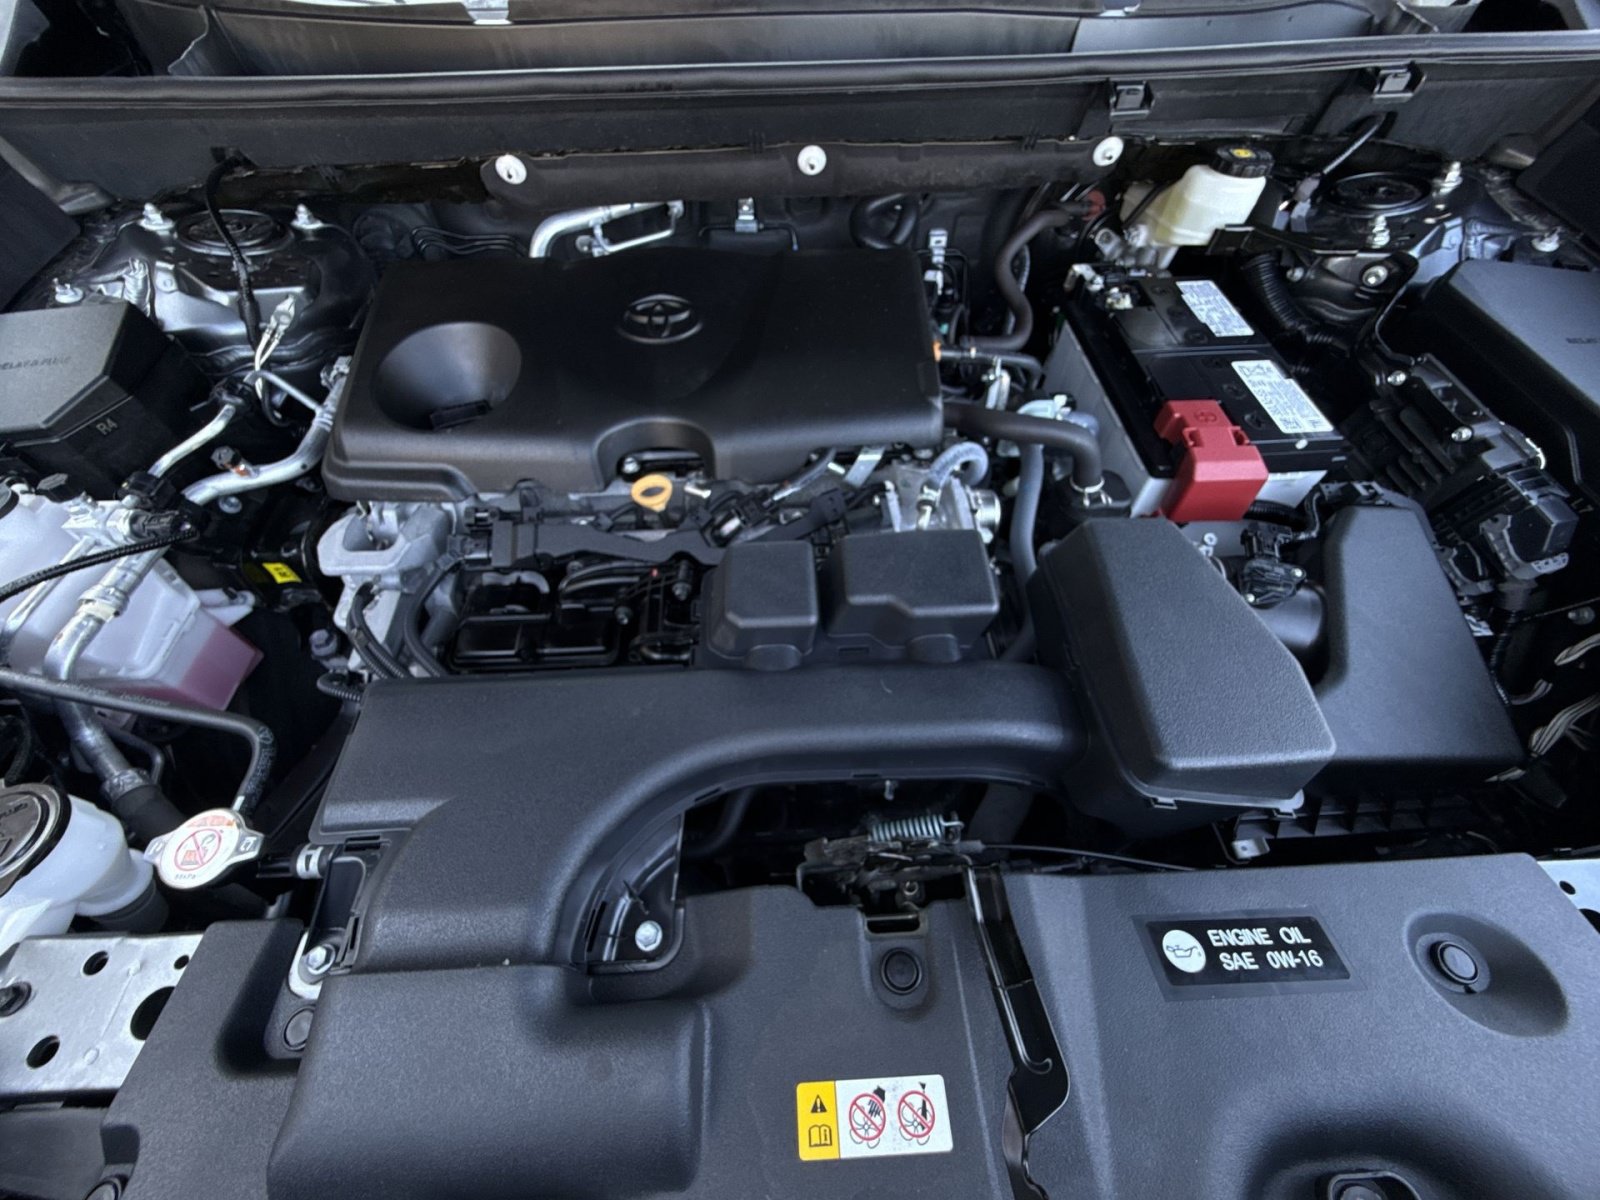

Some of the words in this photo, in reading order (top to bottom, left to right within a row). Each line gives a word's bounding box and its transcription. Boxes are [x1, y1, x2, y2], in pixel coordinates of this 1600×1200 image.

[95, 418, 118, 436] R4
[1206, 927, 1274, 947] ENGINE
[1278, 926, 1312, 944] OIL
[1219, 952, 1260, 971] SAE
[1266, 949, 1324, 969] 0W-16
